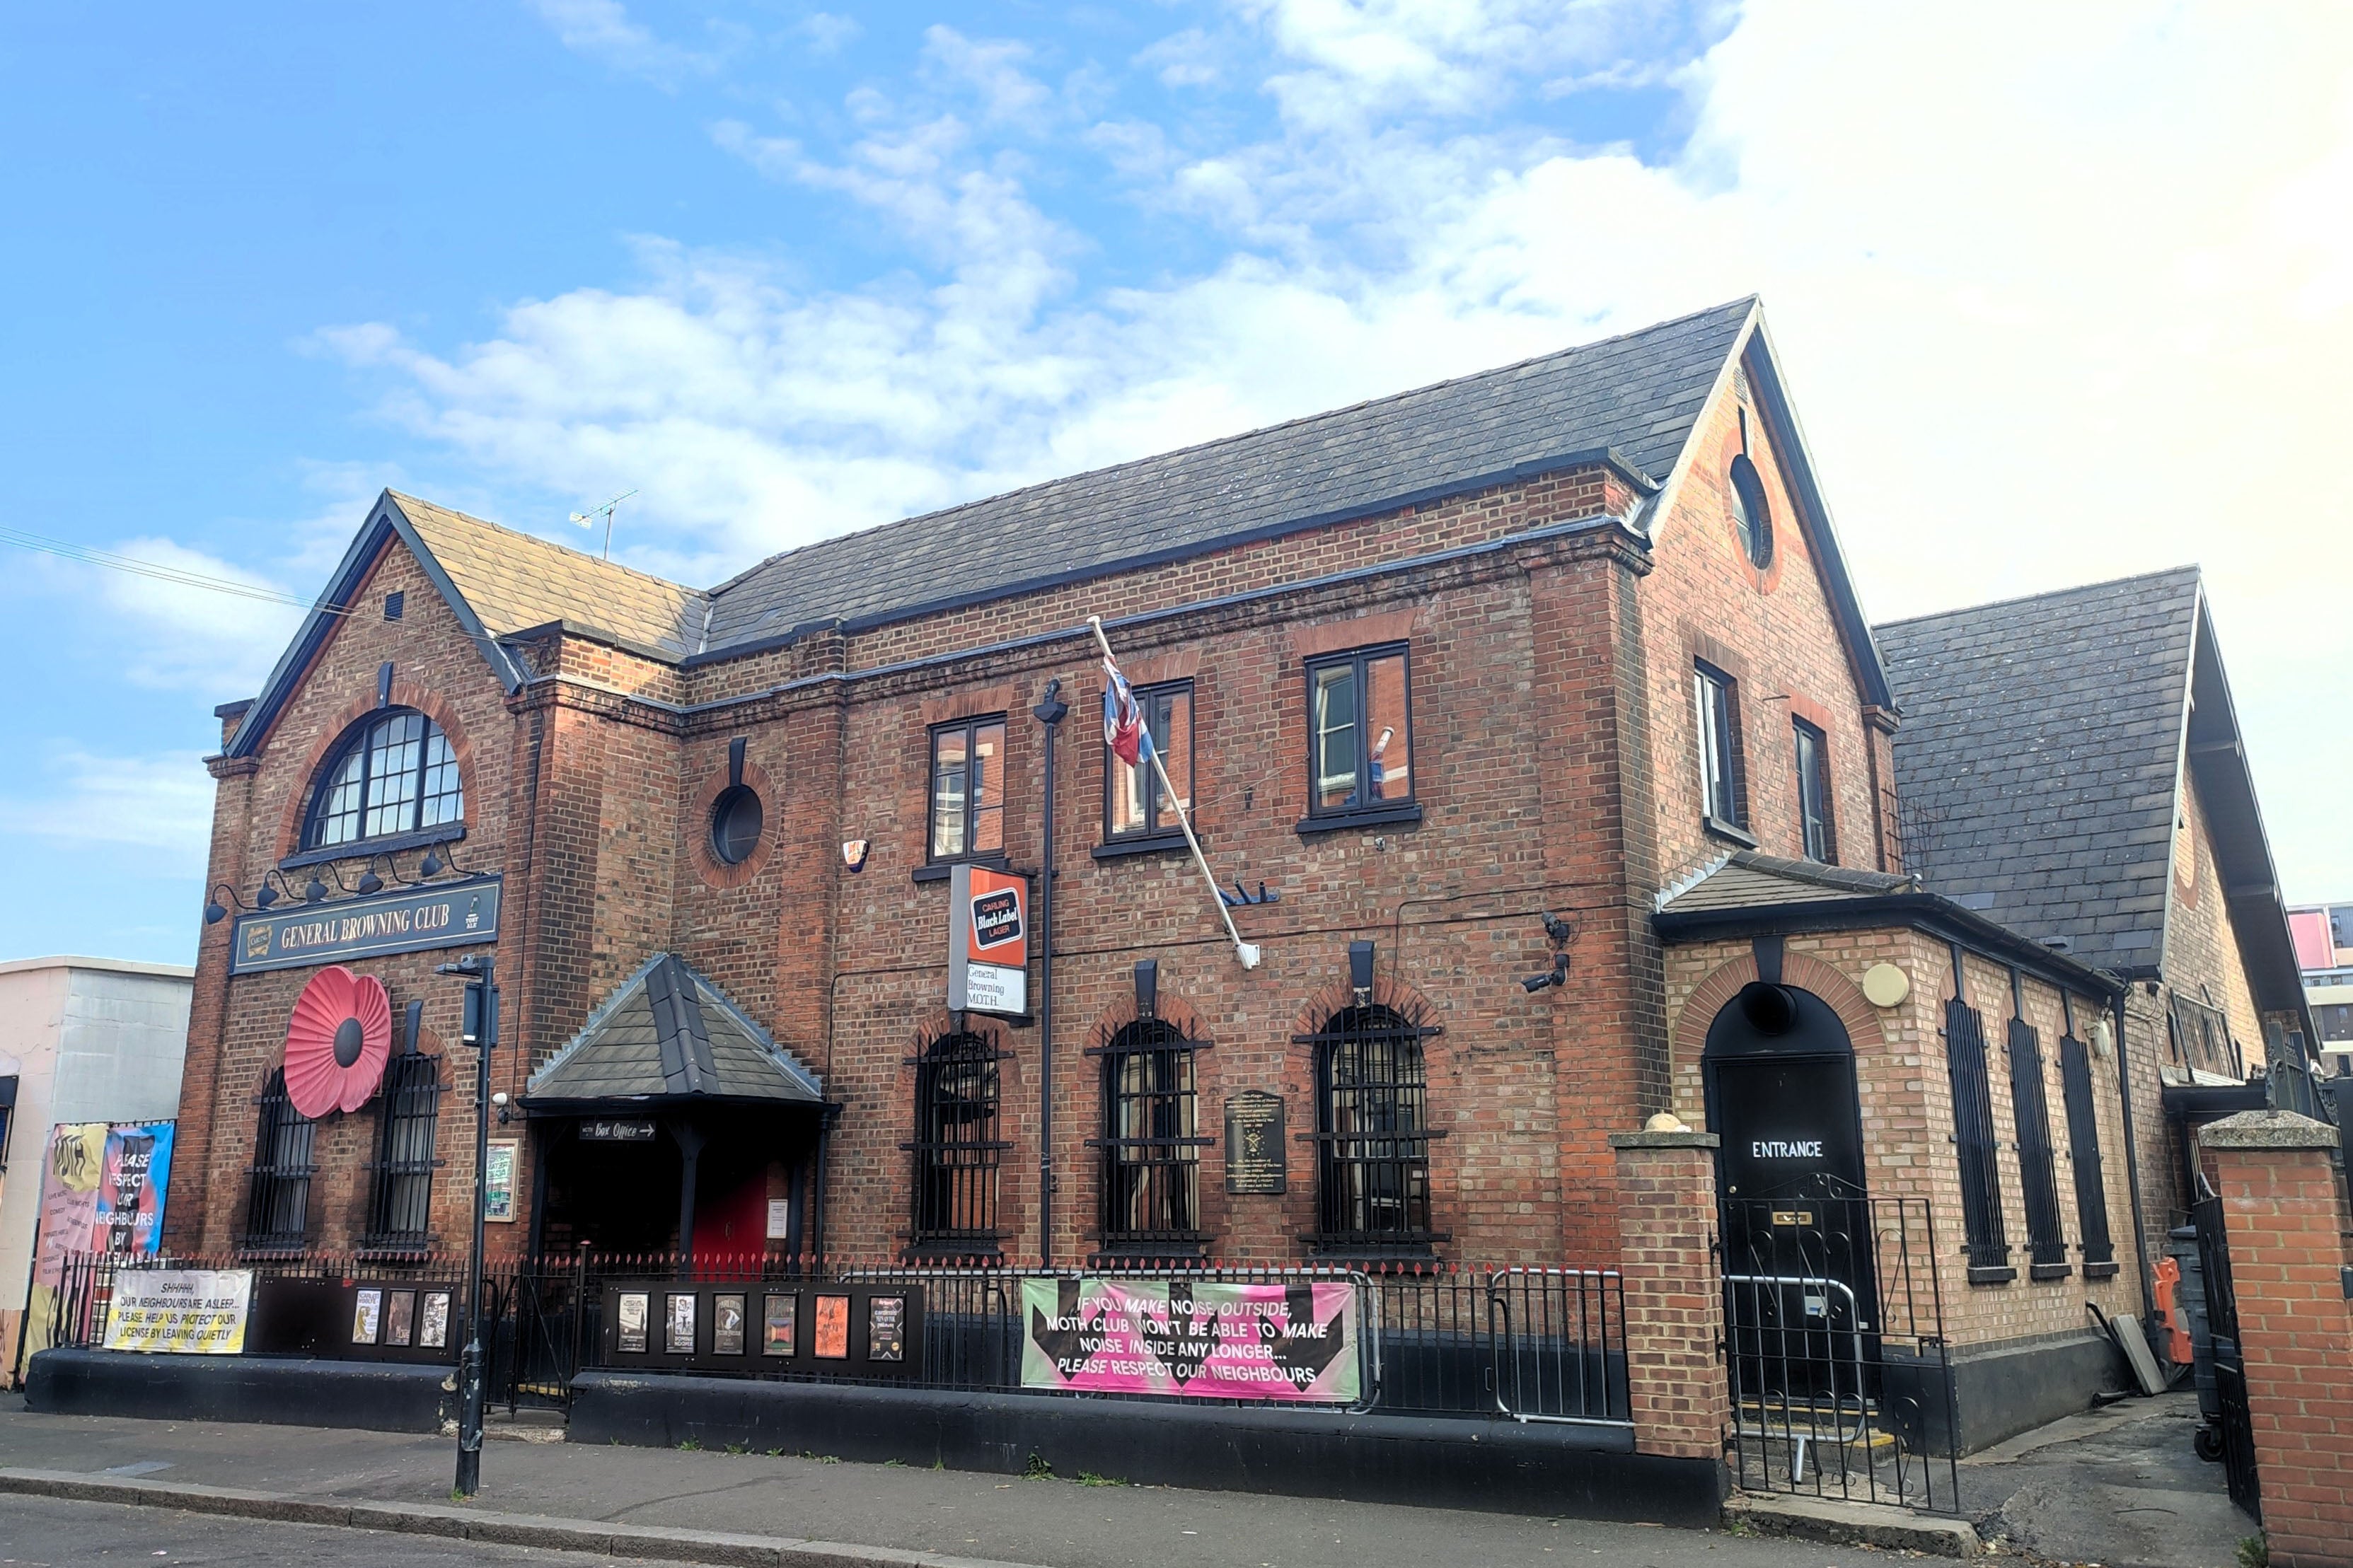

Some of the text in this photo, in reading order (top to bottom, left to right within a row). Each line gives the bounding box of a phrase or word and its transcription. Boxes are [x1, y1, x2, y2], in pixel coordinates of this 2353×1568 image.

[981, 898, 1010, 912] CARLING
[282, 904, 450, 949] GENERAL BROWNING CLUB
[977, 907, 1018, 931] Black Label
[988, 924, 1010, 938] LAGER
[968, 966, 998, 980] General
[968, 979, 1005, 996] Browning
[595, 1122, 611, 1137] Box
[613, 1122, 637, 1139] Office
[1752, 1141, 1823, 1158] ENTRANCE
[115, 1154, 151, 1168] PLEASE
[115, 1231, 126, 1246] BY
[120, 1296, 240, 1309] OUR NEIGHBOURS ARE ASLEEP...
[1077, 1297, 1293, 1318] IF YOU MAKE NOISE OUTSIDE,
[117, 1311, 236, 1325] PLEASE HELP US PROTECT OUR
[120, 1327, 232, 1340] LICENSE BY LEAVING QUIETLY
[1046, 1316, 1329, 1339] MOTH CLUB WON'T BE ABLE TO MAKE
[1079, 1337, 1287, 1360] NOISE INSIDE ANY LONGER...
[1056, 1357, 1317, 1383] PLEASE RESPECT OUR NEIGHBOURS
